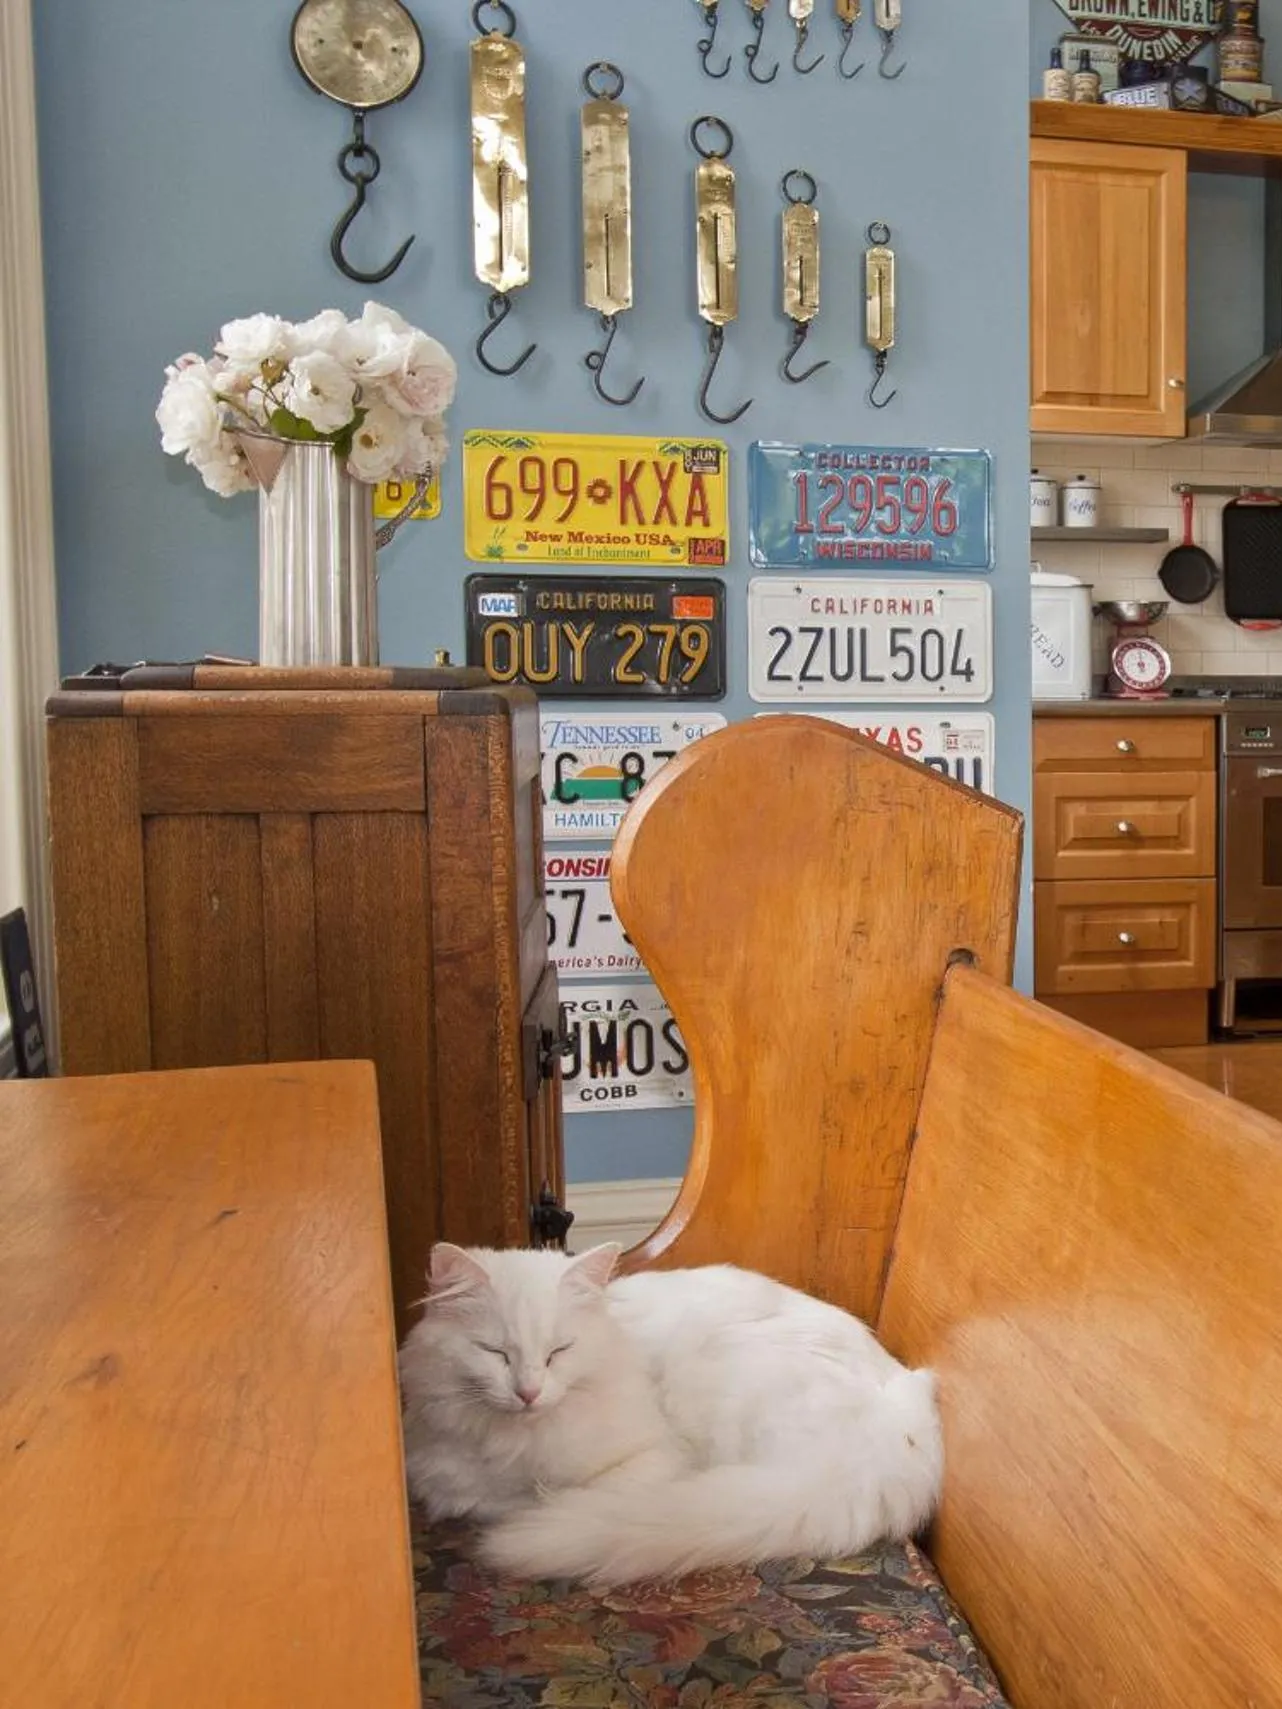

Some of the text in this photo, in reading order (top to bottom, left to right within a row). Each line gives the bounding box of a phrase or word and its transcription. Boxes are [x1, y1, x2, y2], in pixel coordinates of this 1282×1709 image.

[1105, 23, 1183, 61] DUNEDIN
[815, 452, 931, 471] COLLECTOR
[484, 455, 711, 528] 699 KXA
[793, 471, 960, 537] 129596
[525, 530, 677, 546] New Mexico USA
[814, 540, 933, 561] WISCONSIN
[536, 592, 655, 611] CALIFORNIA
[810, 598, 935, 615] CALIFORNIA
[483, 621, 710, 684] OUY 279
[766, 626, 975, 683] 2ZUL504
[541, 720, 663, 749] TENNESSEE
[859, 727, 923, 753] XAS
[554, 812, 625, 828] HAMILT
[546, 857, 612, 878] ONSI
[550, 955, 645, 971] erica's Dairy
[560, 1000, 640, 1013] RGIA
[580, 1085, 638, 1102] COBB
